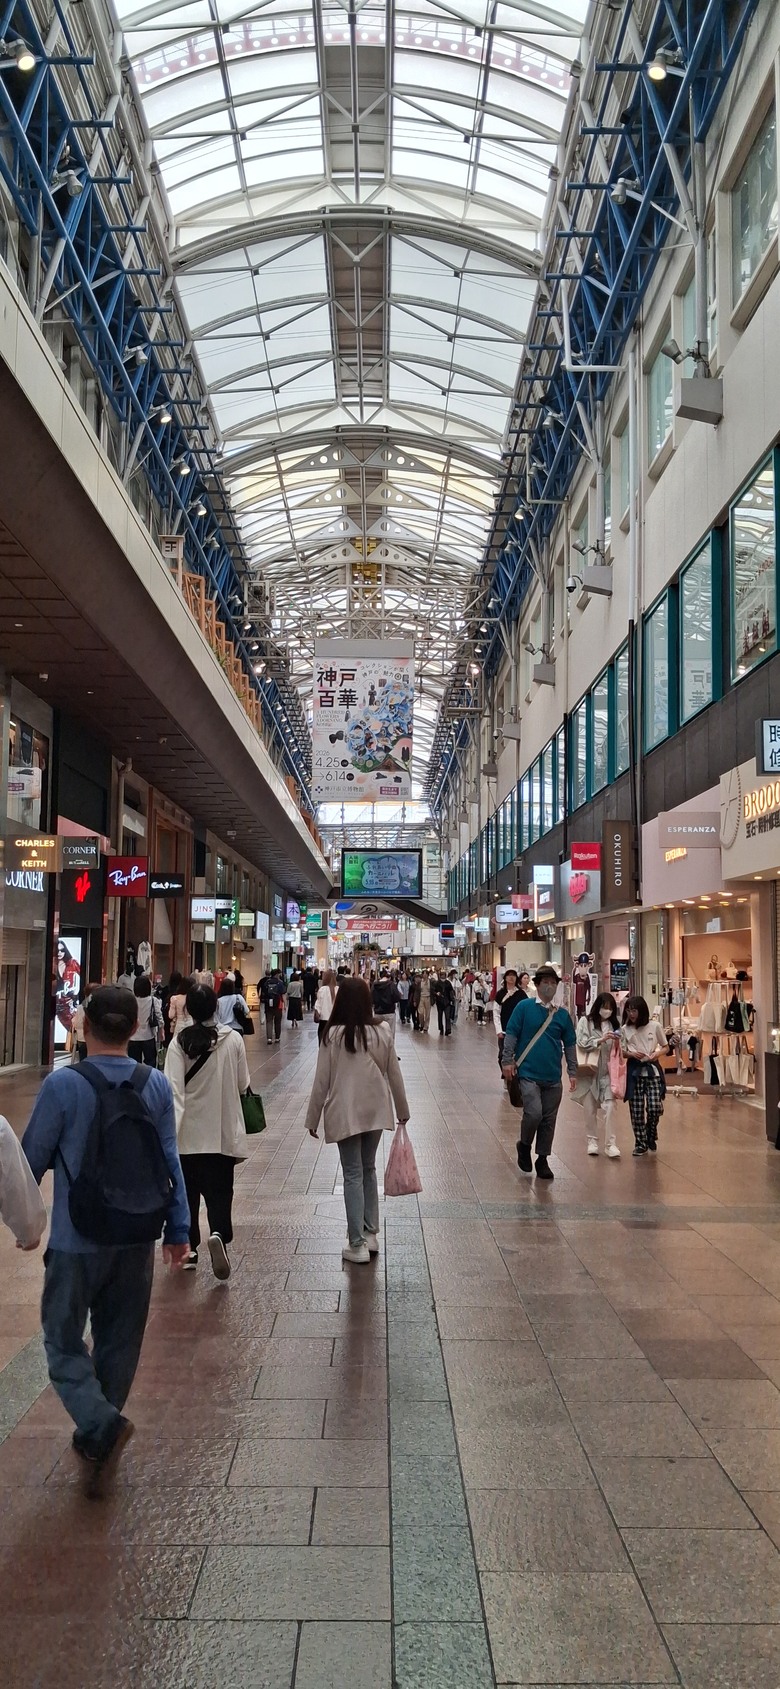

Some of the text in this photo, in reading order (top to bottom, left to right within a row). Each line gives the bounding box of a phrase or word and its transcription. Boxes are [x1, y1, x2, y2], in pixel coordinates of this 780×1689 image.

[317, 667, 358, 687] 神戸
[317, 689, 358, 709] 百華
[315, 757, 340, 767] 4.25
[325, 771, 346, 781] 6.14
[15, 839, 55, 847] CHARLES
[63, 846, 96, 855] CORNER
[574, 853, 598, 861] Rakuten
[613, 834, 622, 886] OKUHIRO
[109, 866, 147, 886] Ray-Ban
[288, 904, 299, 916] 本
